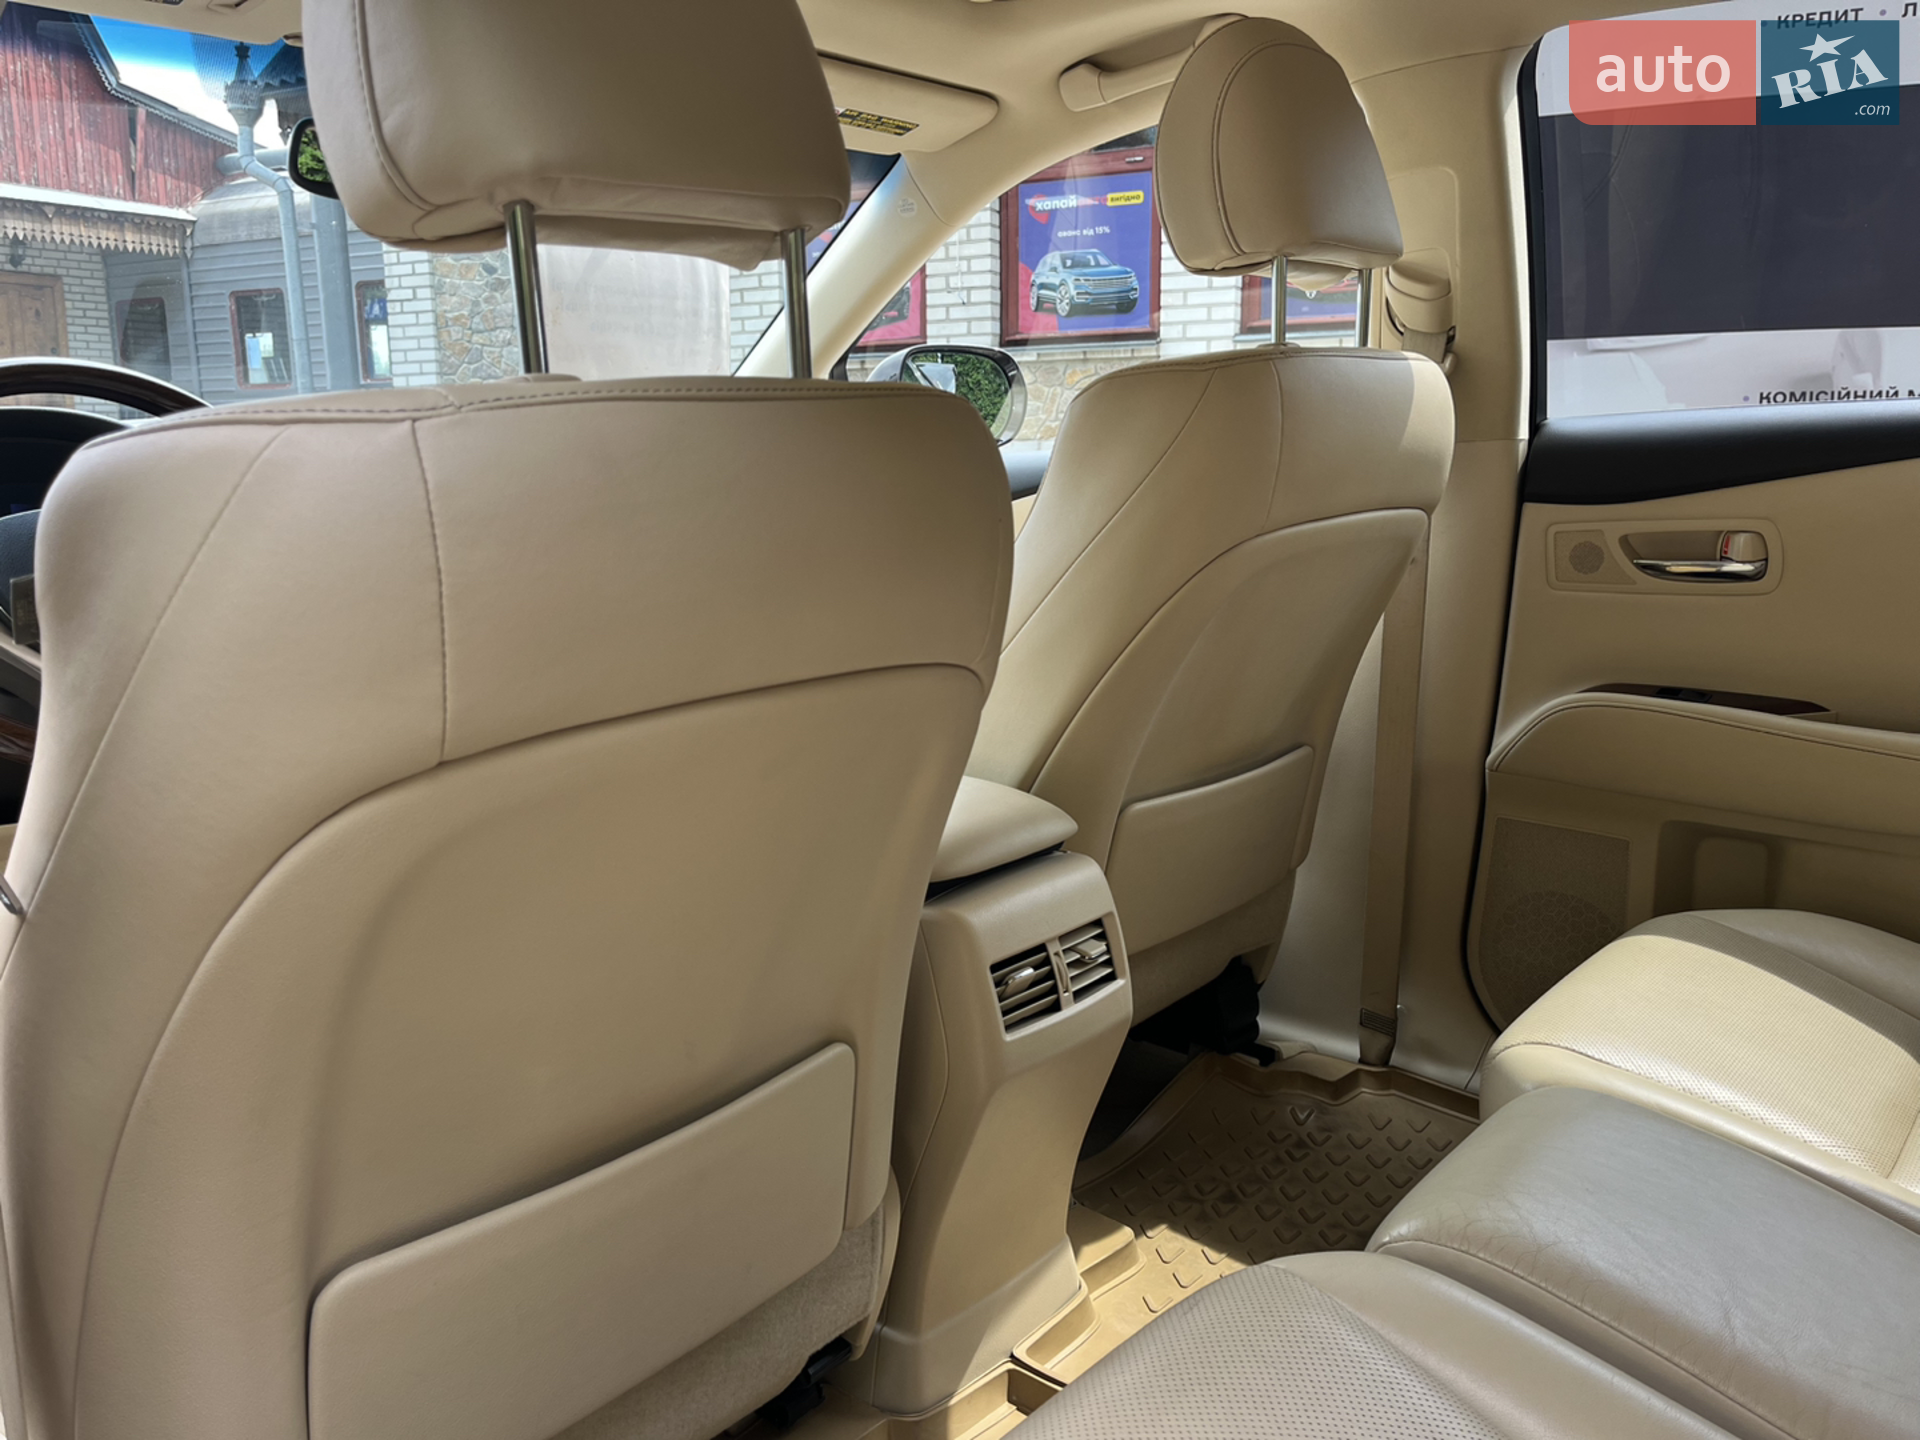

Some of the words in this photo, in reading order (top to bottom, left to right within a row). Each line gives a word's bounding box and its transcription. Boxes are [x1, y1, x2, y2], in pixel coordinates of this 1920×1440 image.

[1777, 7, 1864, 29] КРЕДИТ
[1035, 194, 1077, 212] хапай
[1110, 194, 1141, 203] вигідно
[1057, 230, 1081, 238] аванс
[1082, 227, 1094, 237] від
[1095, 225, 1111, 235] 15%
[1759, 386, 1899, 405] КОМІСІЙНИЙ
